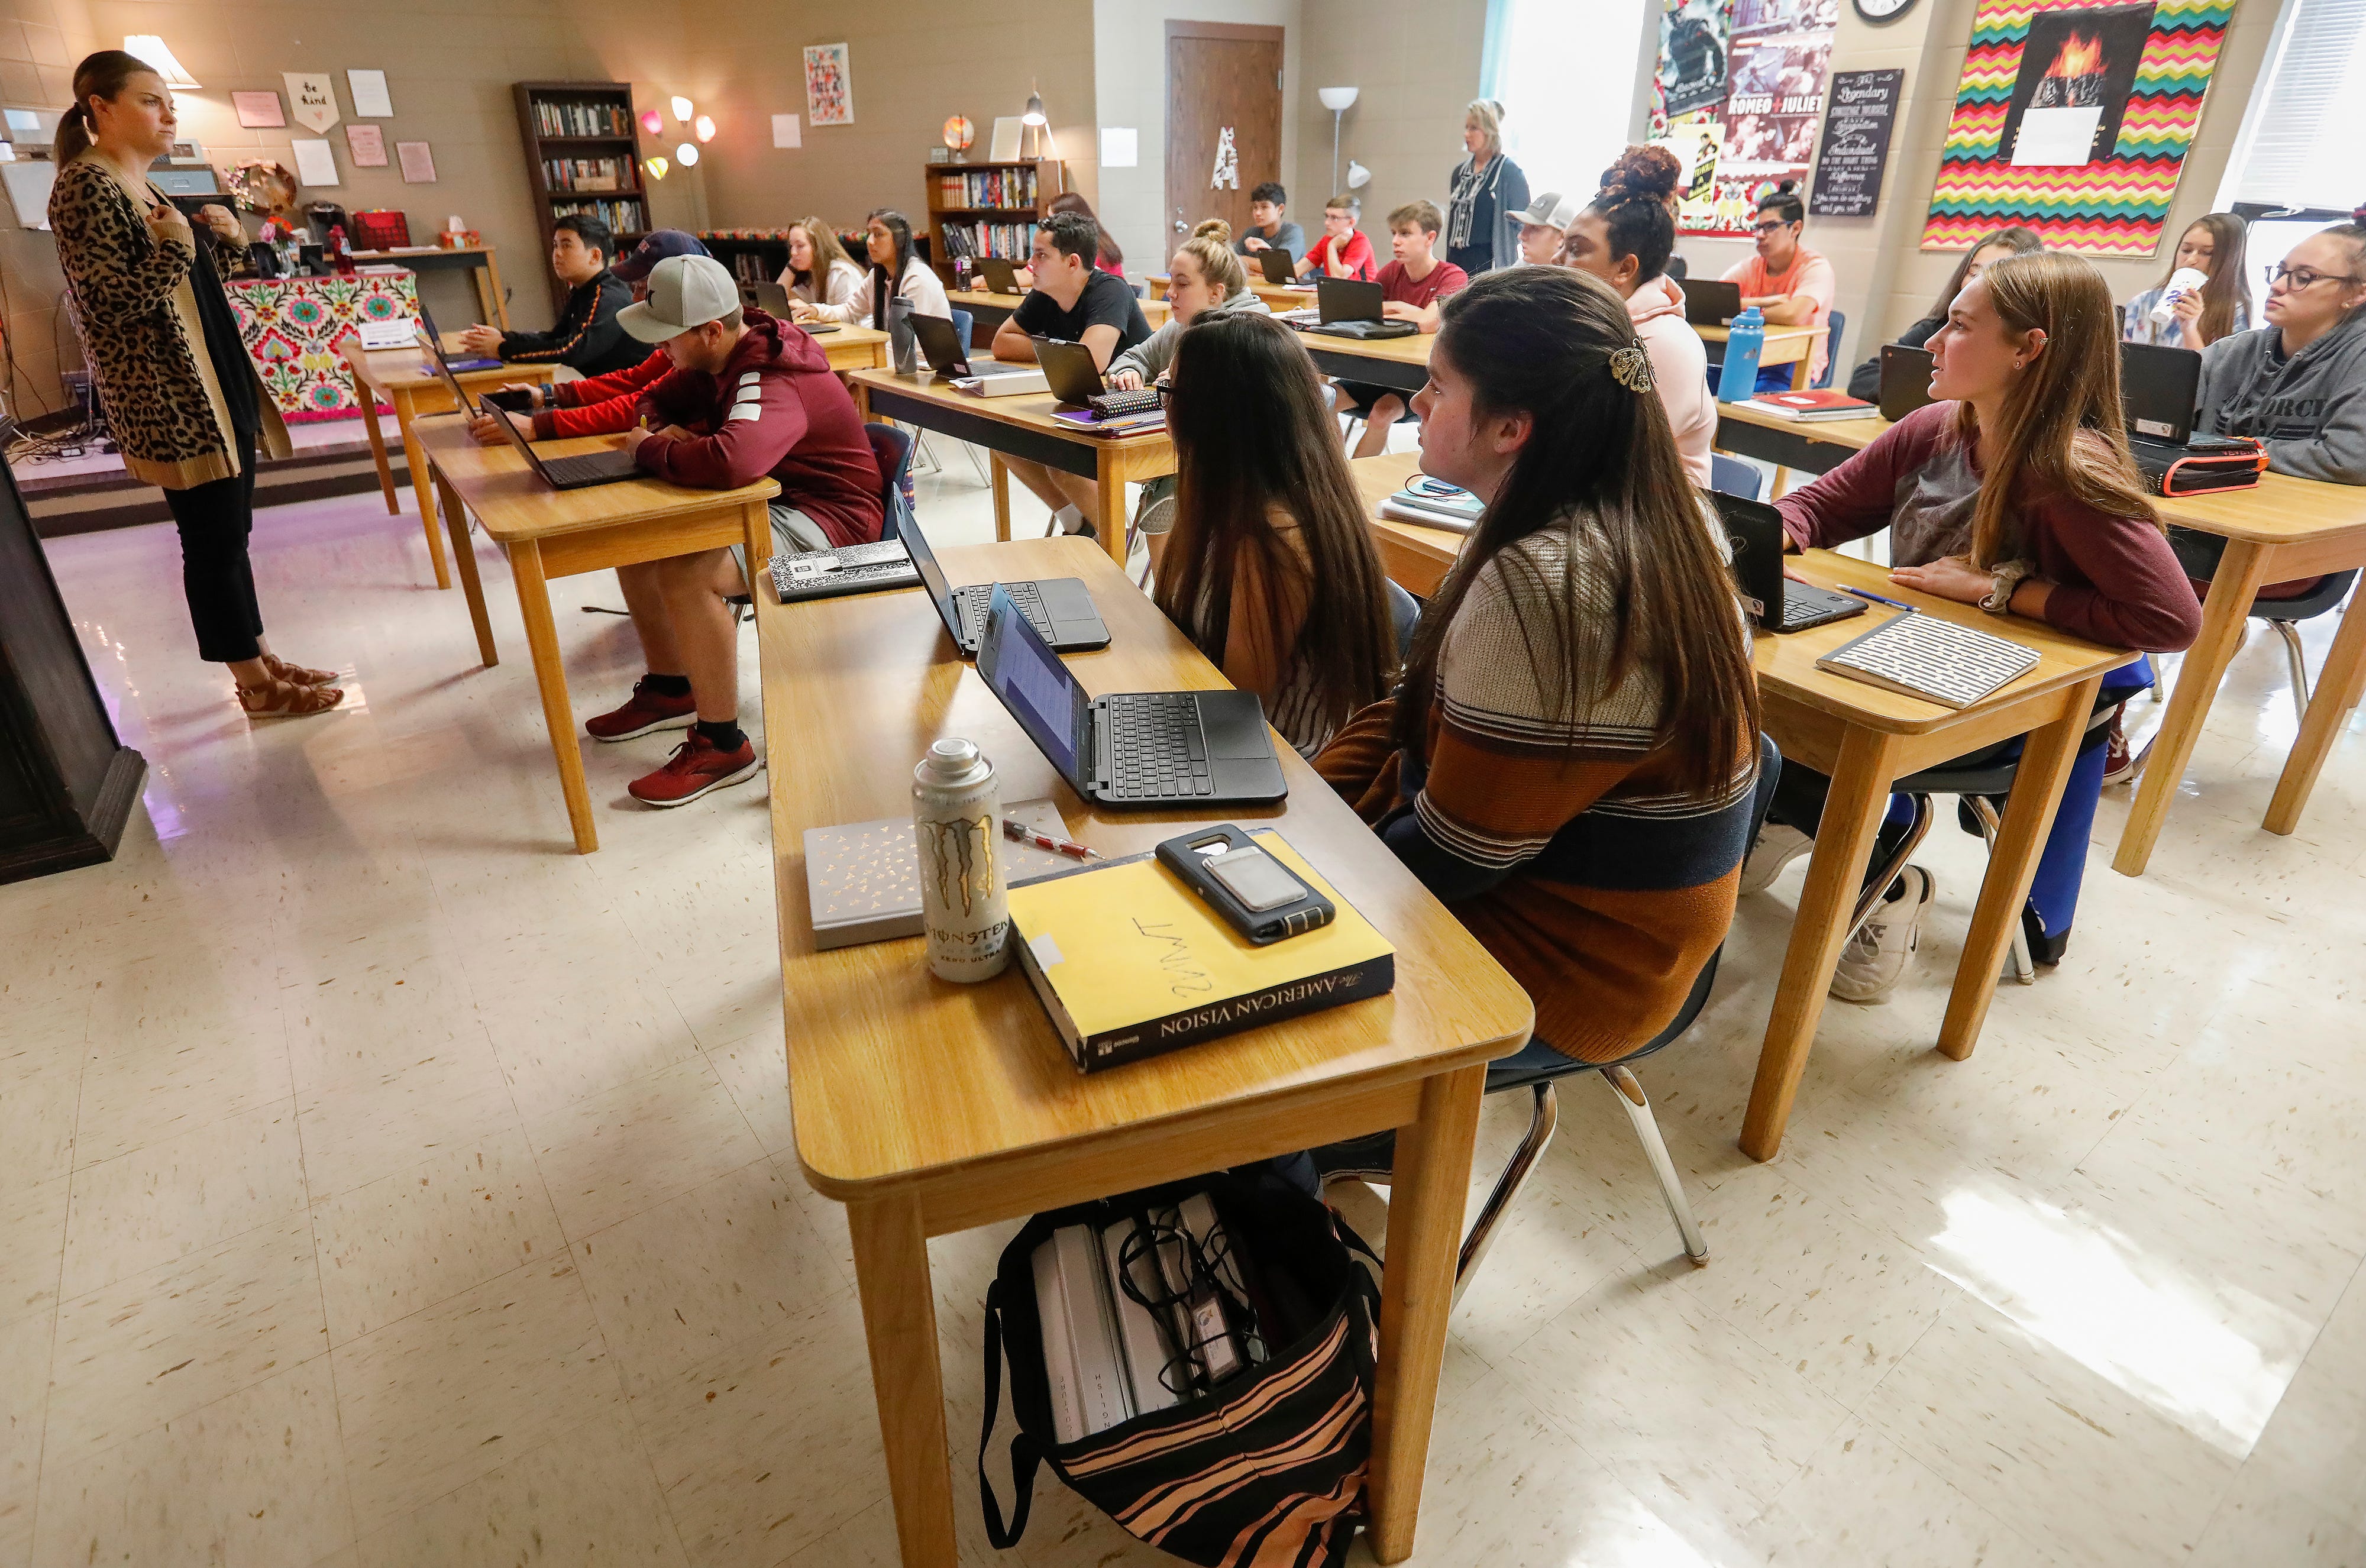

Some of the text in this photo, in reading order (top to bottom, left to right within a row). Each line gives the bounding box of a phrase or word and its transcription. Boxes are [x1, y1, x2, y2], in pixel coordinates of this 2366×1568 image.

[303, 80, 318, 93] be
[302, 95, 328, 105] kind
[1727, 97, 1773, 115] ROMEO
[1780, 95, 1823, 114] JULIET
[1161, 972, 1363, 1038] The AMERICAN VISION
[1095, 1373, 1110, 1428] NGLISH
